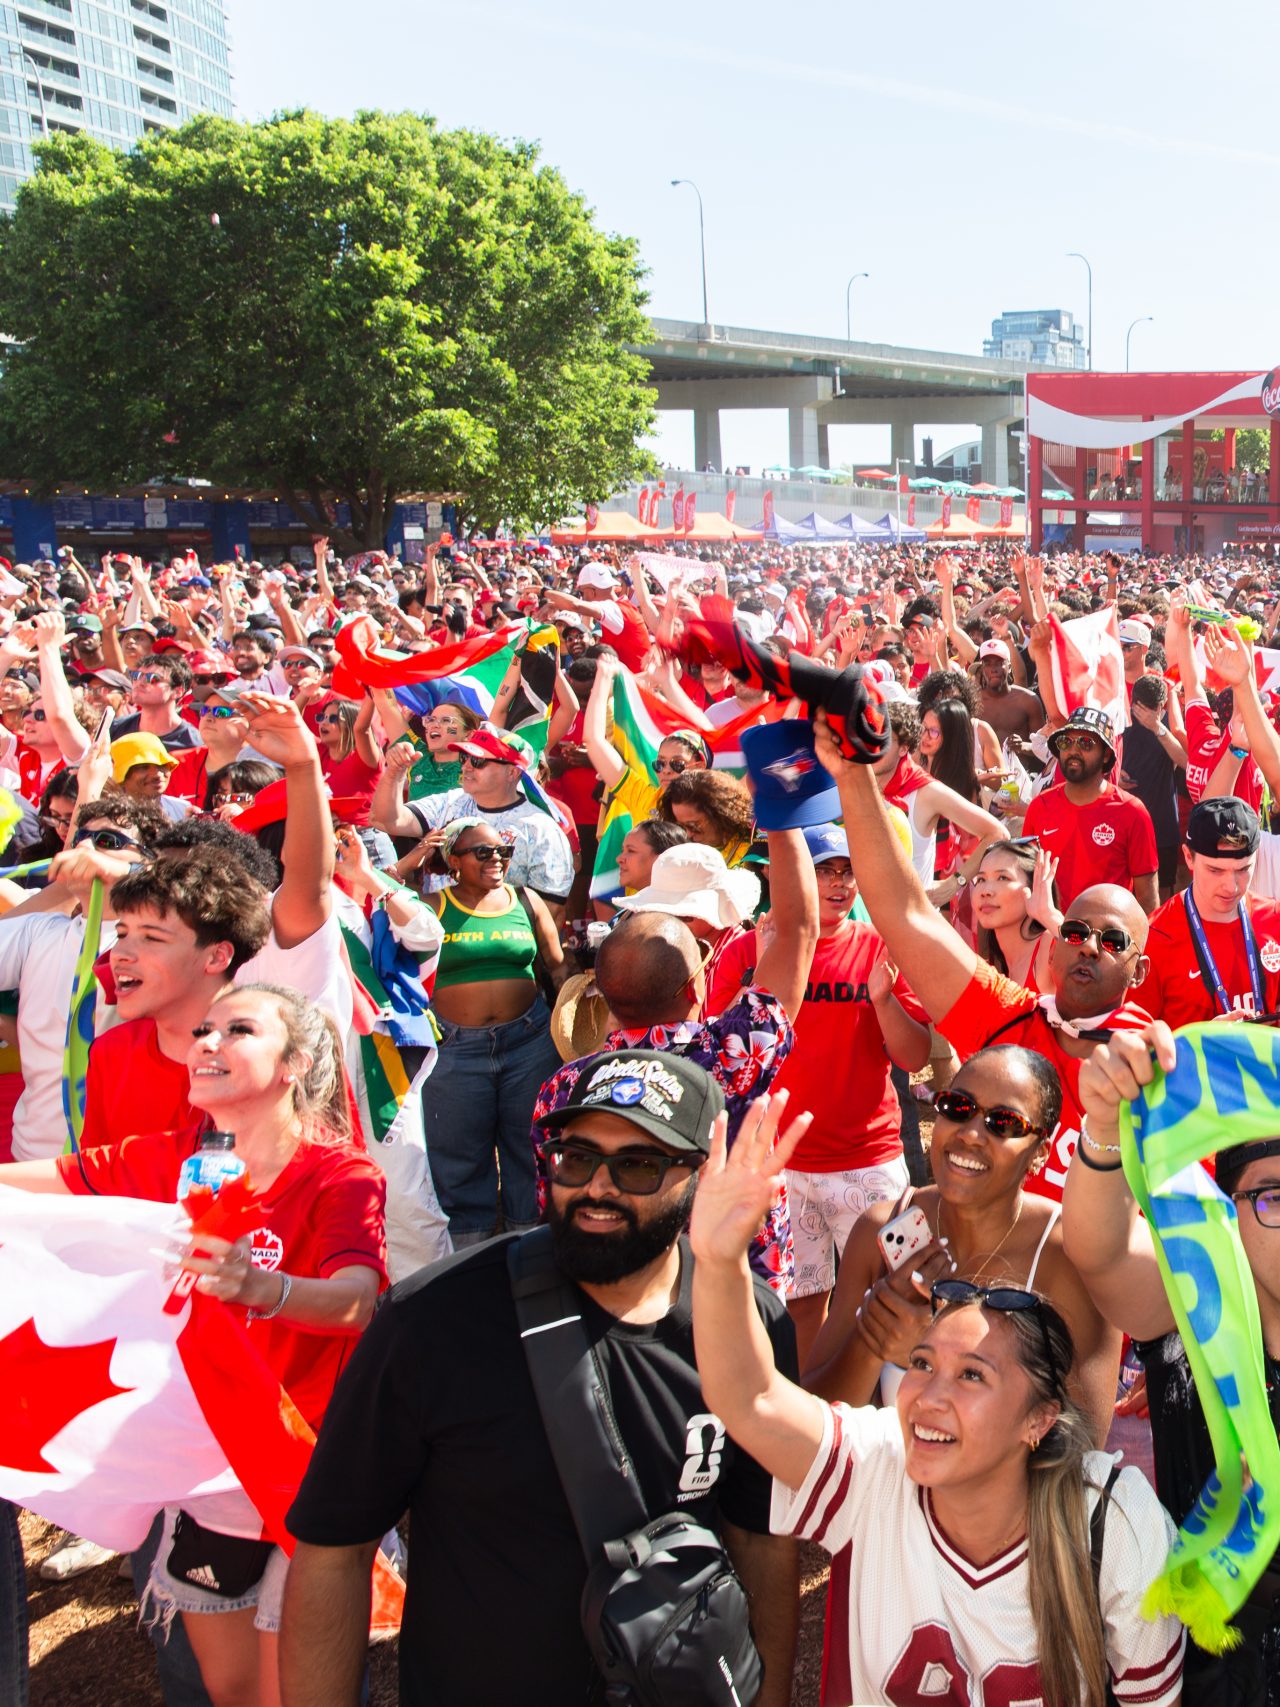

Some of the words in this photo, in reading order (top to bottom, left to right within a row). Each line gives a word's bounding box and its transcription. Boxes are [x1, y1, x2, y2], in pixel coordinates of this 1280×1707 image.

[442, 931, 484, 944] OUTH
[691, 1475, 711, 1484] FIFA
[186, 1570, 220, 1590] adidas
